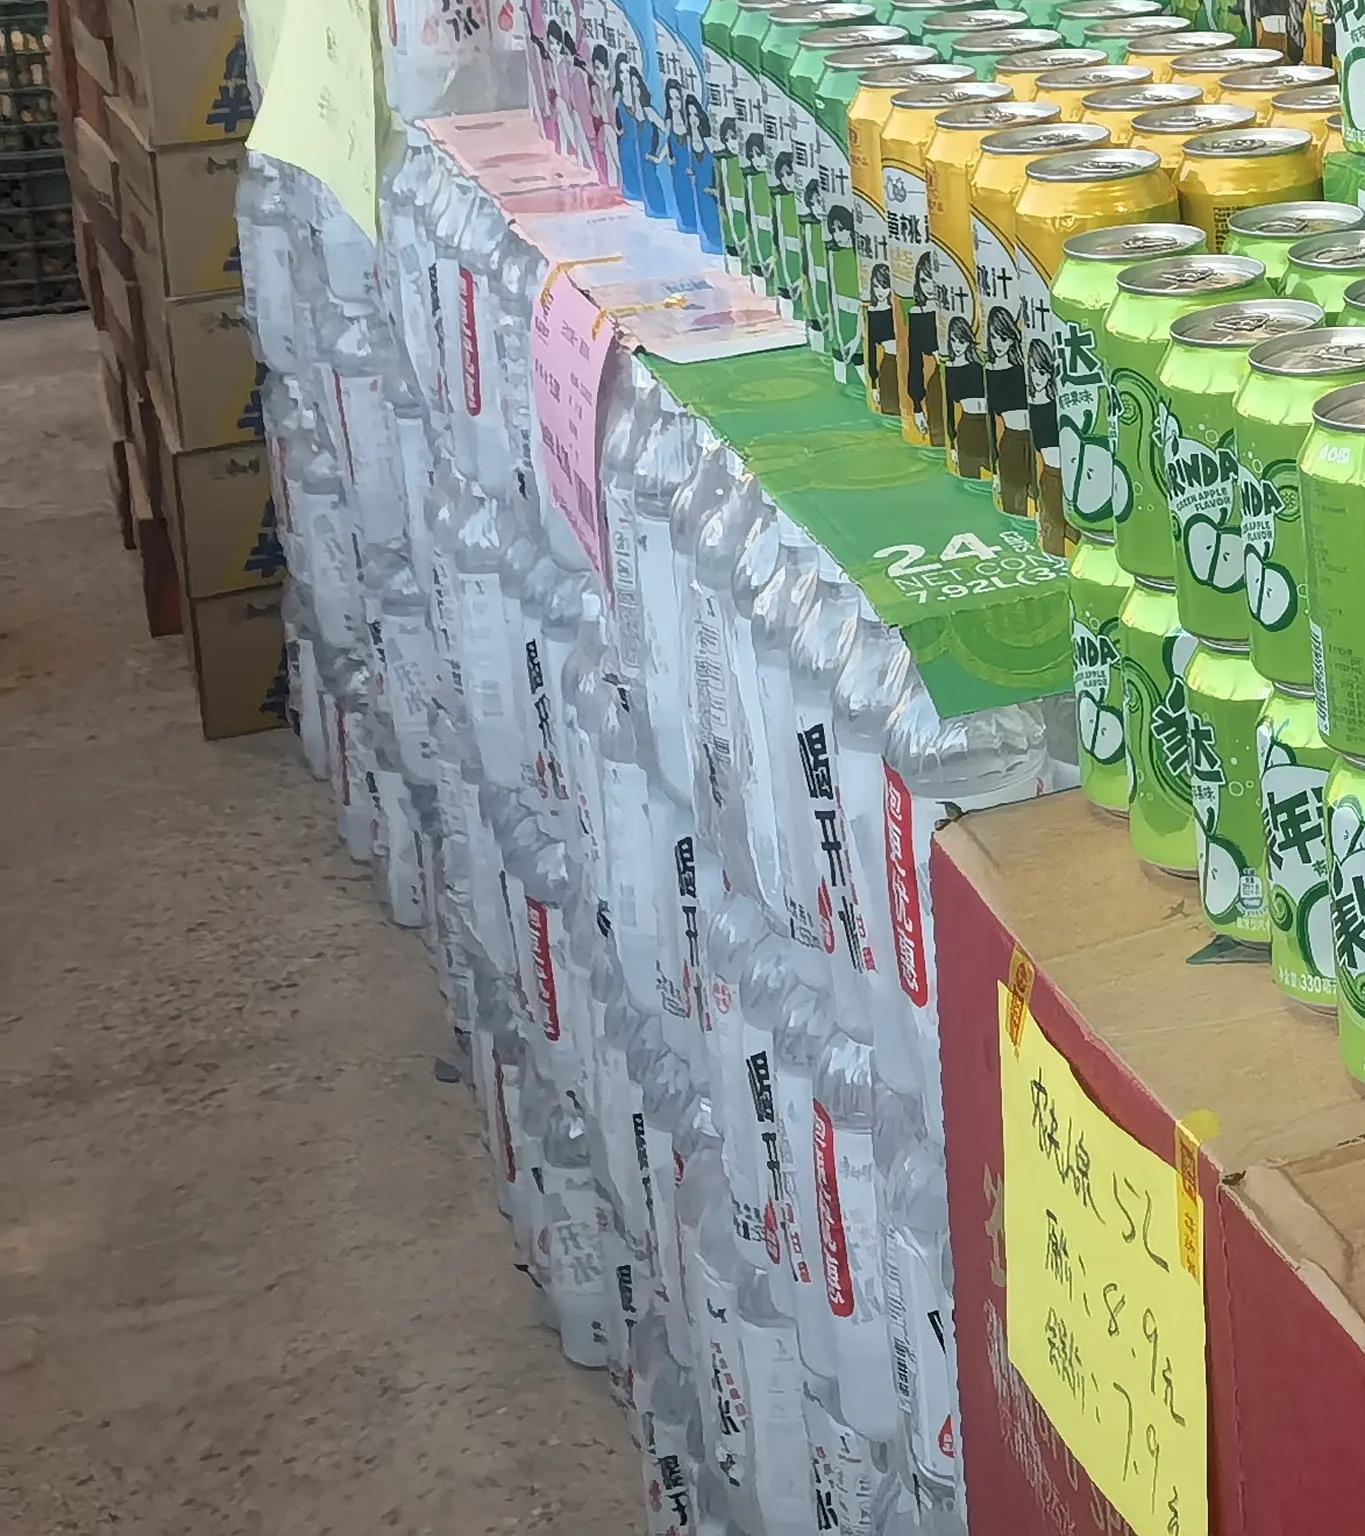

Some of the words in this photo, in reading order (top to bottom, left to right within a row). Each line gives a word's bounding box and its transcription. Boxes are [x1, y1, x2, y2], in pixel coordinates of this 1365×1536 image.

[1198, 485, 1230, 502] APPLE
[1193, 496, 1232, 513] FLAVOR
[872, 532, 1003, 578] 24
[894, 568, 964, 592] NET
